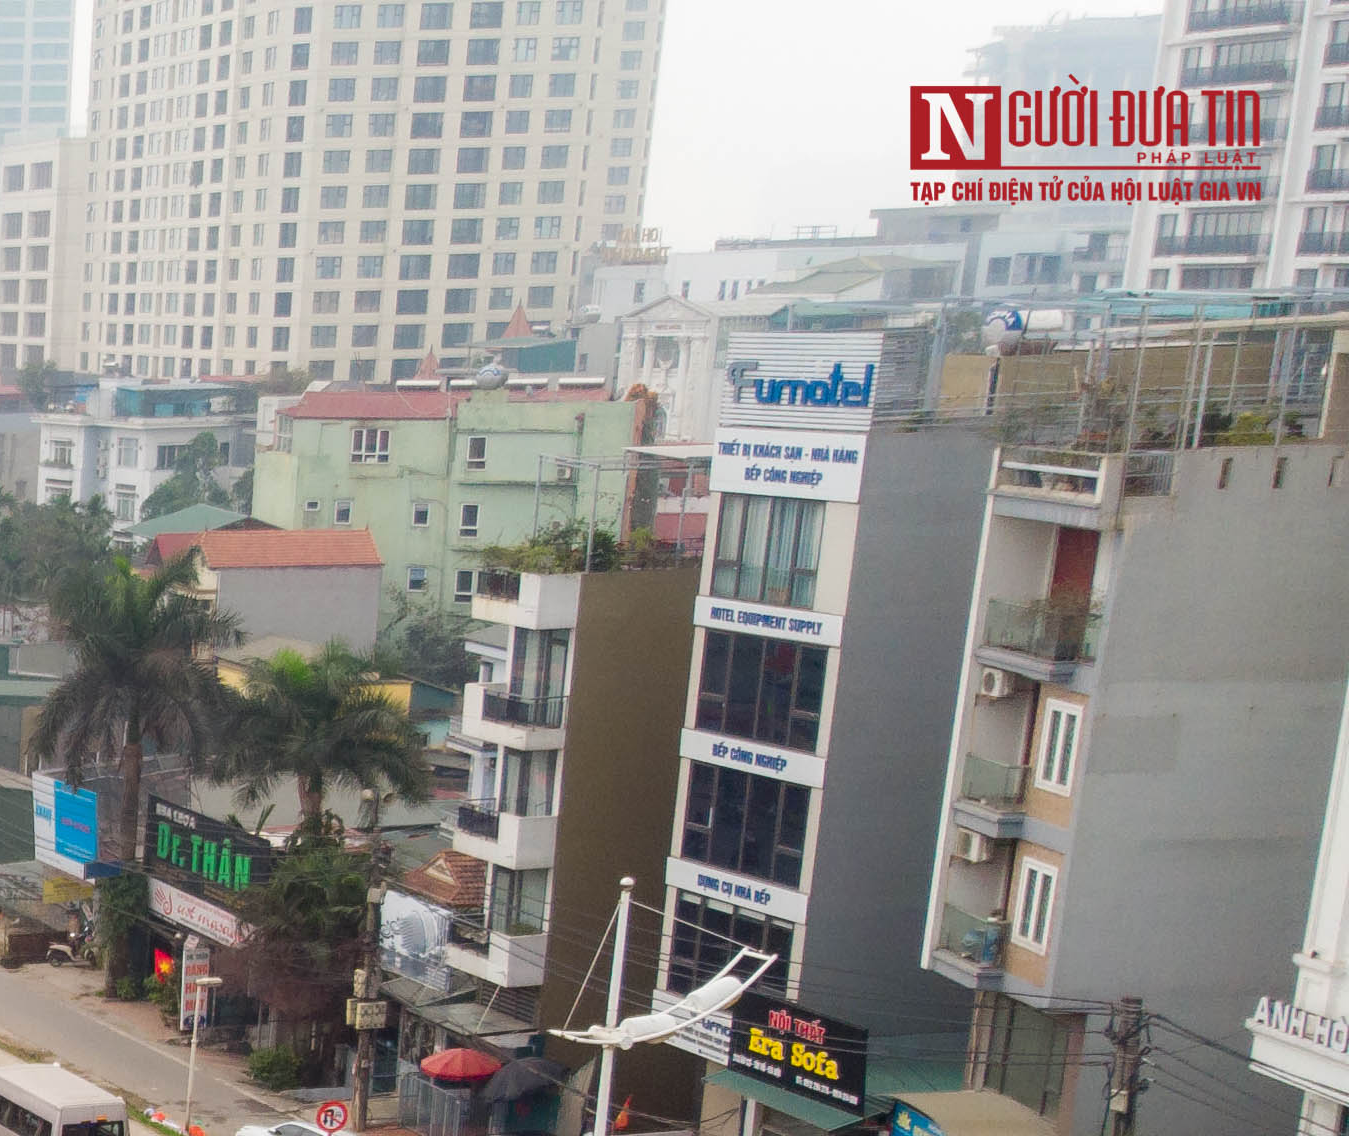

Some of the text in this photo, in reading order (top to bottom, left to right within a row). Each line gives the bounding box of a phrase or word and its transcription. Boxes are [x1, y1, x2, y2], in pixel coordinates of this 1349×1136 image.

[718, 439, 741, 456] THIẾT
[753, 442, 782, 459] KHÁCH
[785, 446, 803, 463] SẠN
[832, 448, 858, 465] HÀNG
[744, 464, 823, 489] BẾP CÔNG NGHIỆP
[710, 606, 823, 636] HOTEL EQUIPMENT SUPPLY
[712, 741, 788, 775] BẾP CÔNG NGHIỆP
[190, 834, 252, 891] THÂN
[754, 887, 771, 906] BẾP
[769, 1009, 826, 1045] NỘI THẤT
[1253, 996, 1308, 1039] ANH
[791, 1042, 840, 1081] Sofa
